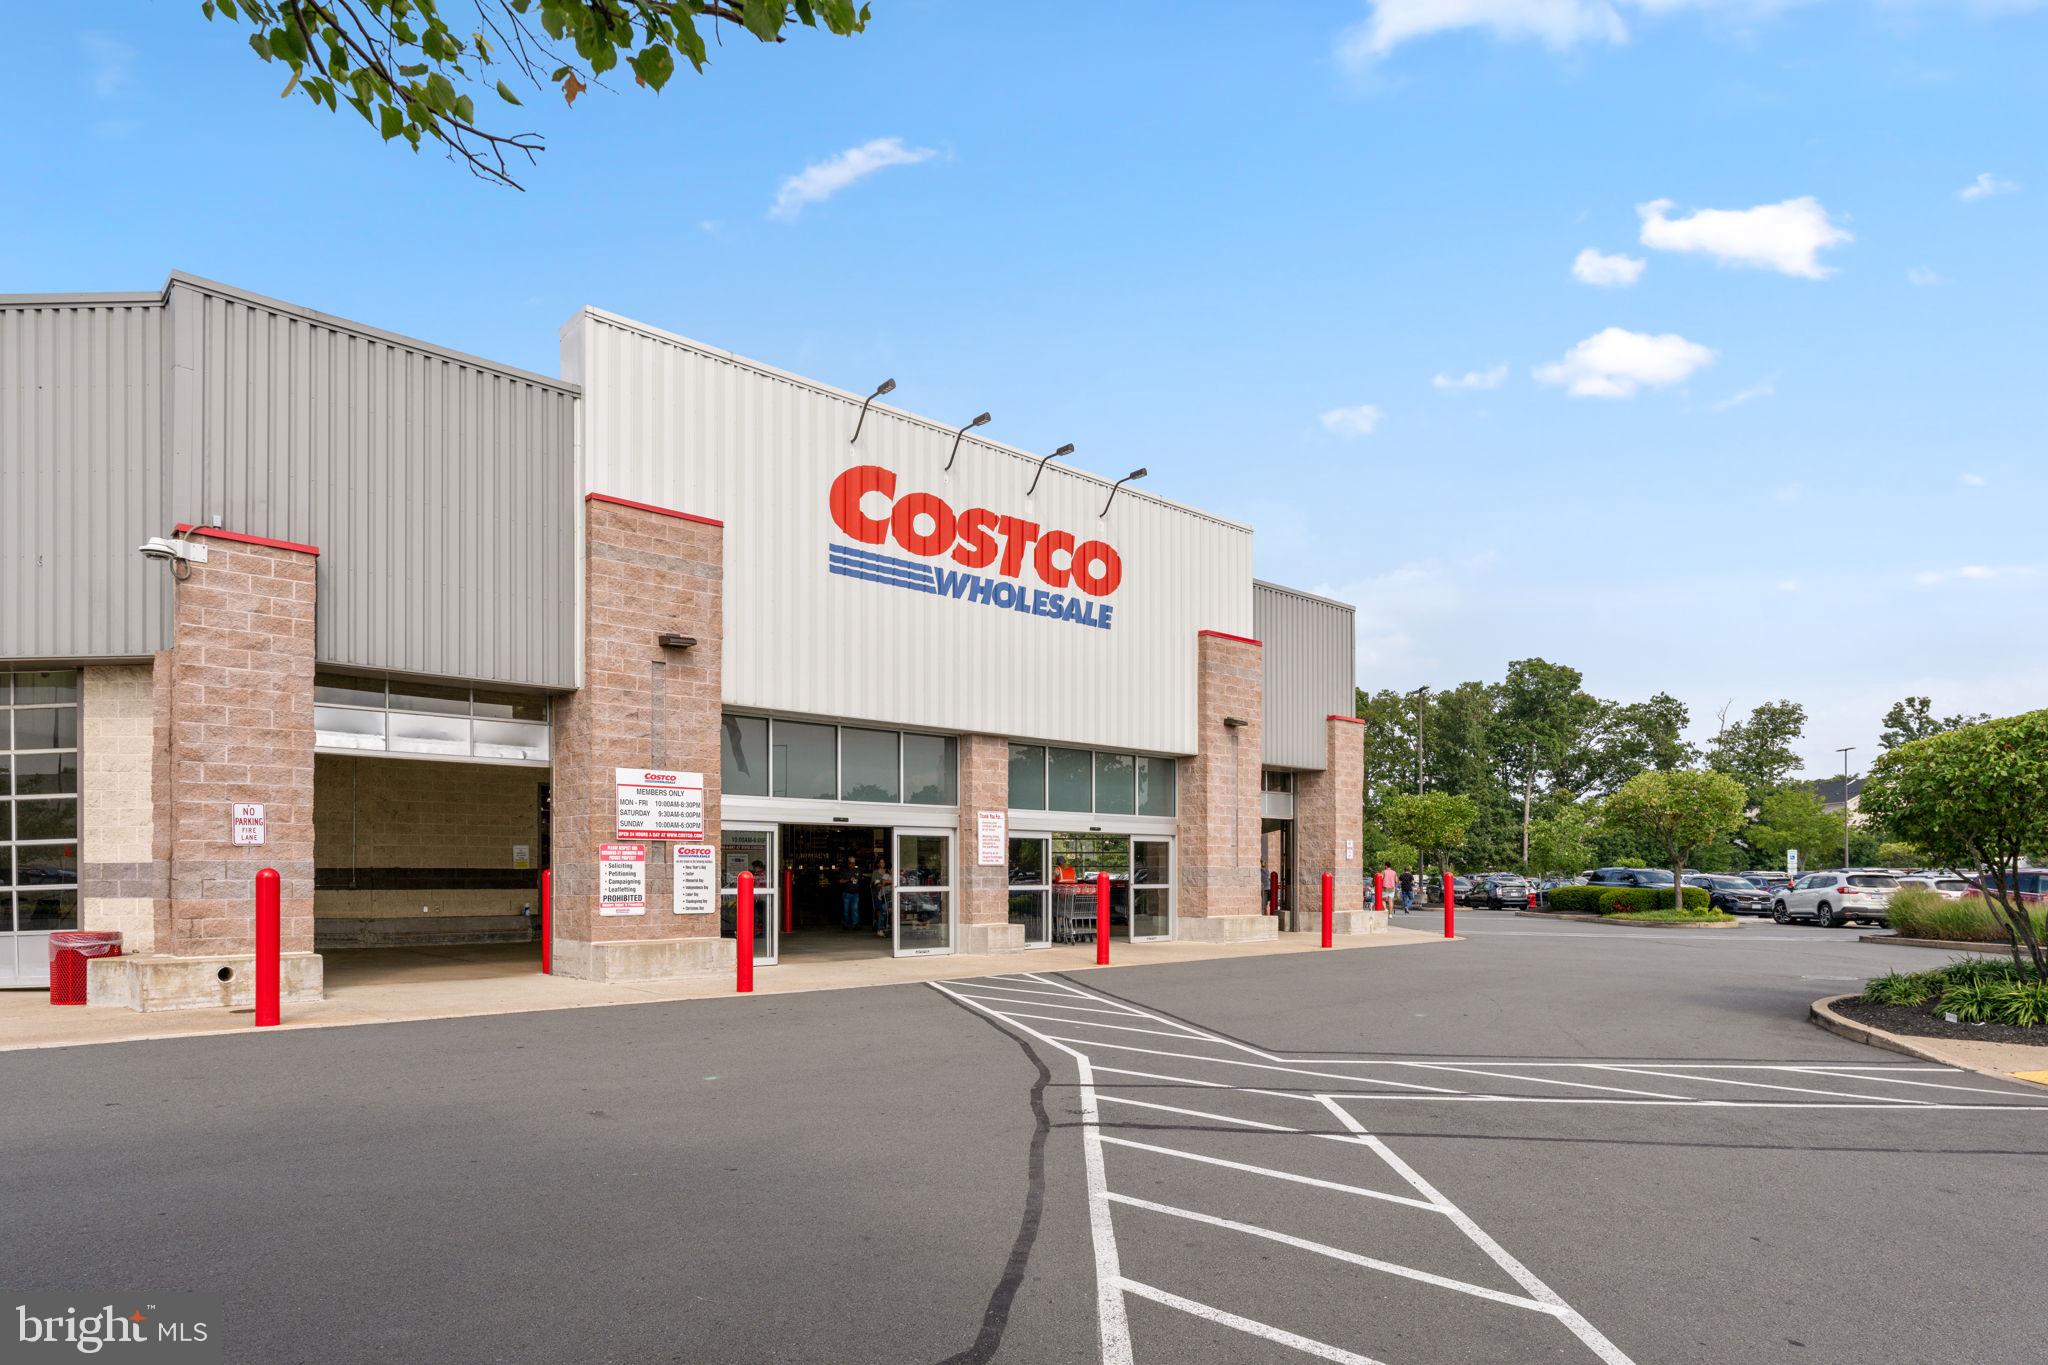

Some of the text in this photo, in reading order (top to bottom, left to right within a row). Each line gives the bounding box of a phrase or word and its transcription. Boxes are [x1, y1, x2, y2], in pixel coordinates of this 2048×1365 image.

[829, 465, 1123, 597] COSTCO
[933, 566, 1114, 630] WHOLESALE
[644, 773, 677, 781] COSTCO
[636, 788, 685, 797] MEMBERS ONLY
[243, 807, 255, 816] NO
[619, 809, 651, 817] SATURDAY
[235, 817, 264, 826] PARKING
[677, 847, 711, 855] COSTCO
[603, 894, 643, 902] PROHIBITED
